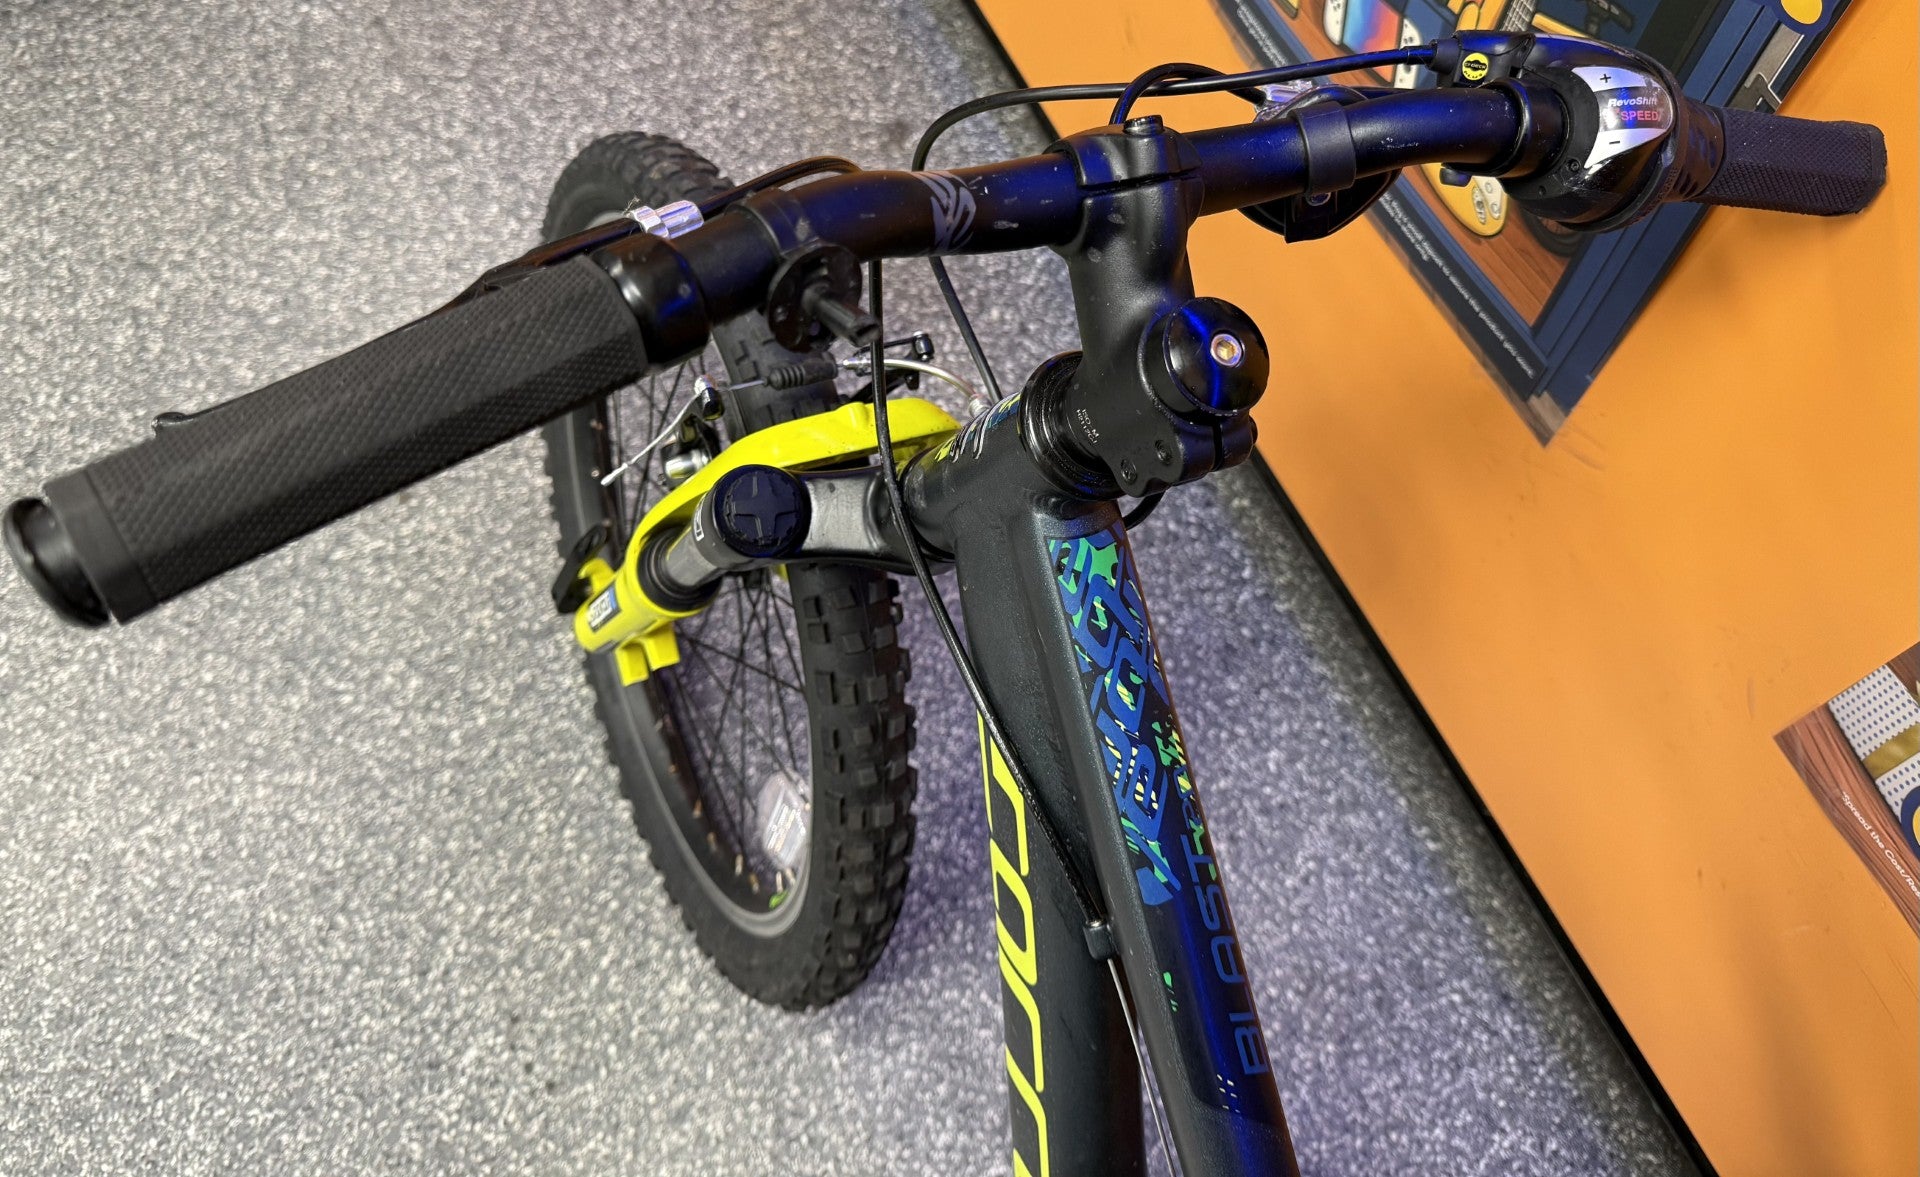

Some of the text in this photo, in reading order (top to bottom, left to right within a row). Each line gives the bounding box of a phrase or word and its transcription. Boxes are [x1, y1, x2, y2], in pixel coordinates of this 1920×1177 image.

[1608, 97, 1658, 107] RevoShift
[1621, 110, 1659, 121] SPEED
[1869, 830, 1885, 849] the
[1180, 834, 1270, 1076] BLAST
